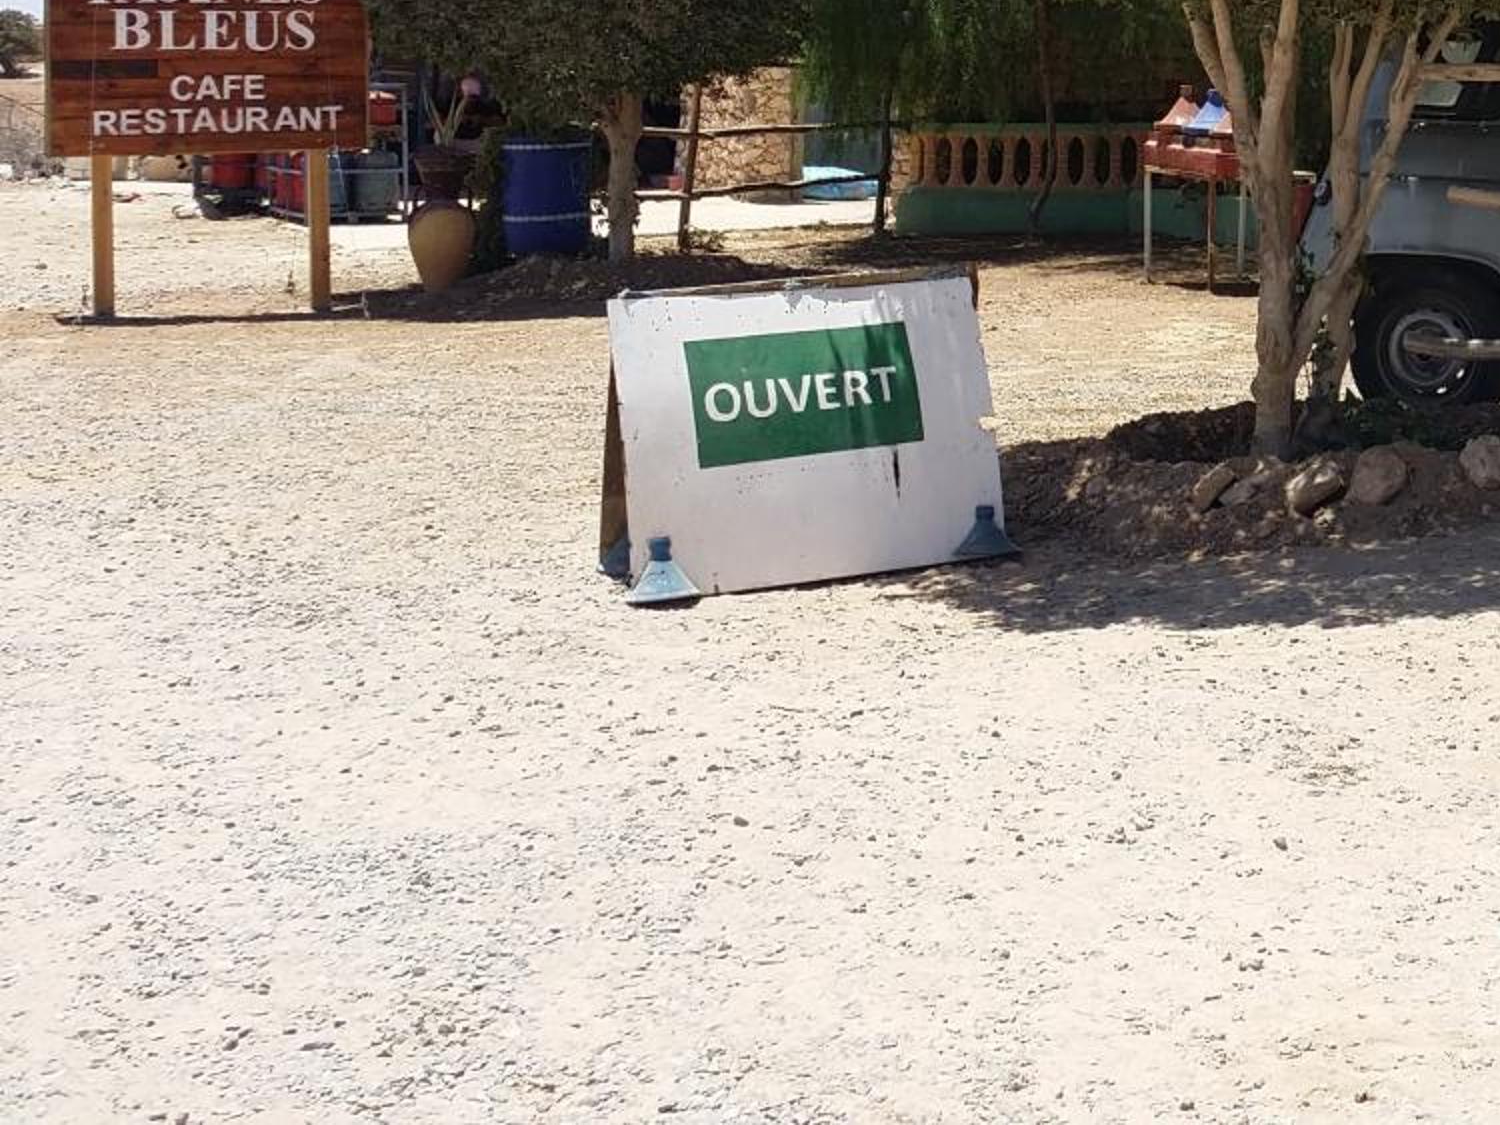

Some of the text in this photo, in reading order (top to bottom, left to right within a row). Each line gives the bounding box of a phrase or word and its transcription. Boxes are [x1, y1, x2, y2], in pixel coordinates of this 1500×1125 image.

[112, 9, 316, 51] BLEUS
[169, 75, 266, 101] CAFE
[92, 105, 344, 136] RESTAURANT
[704, 366, 896, 422] OUVERT
